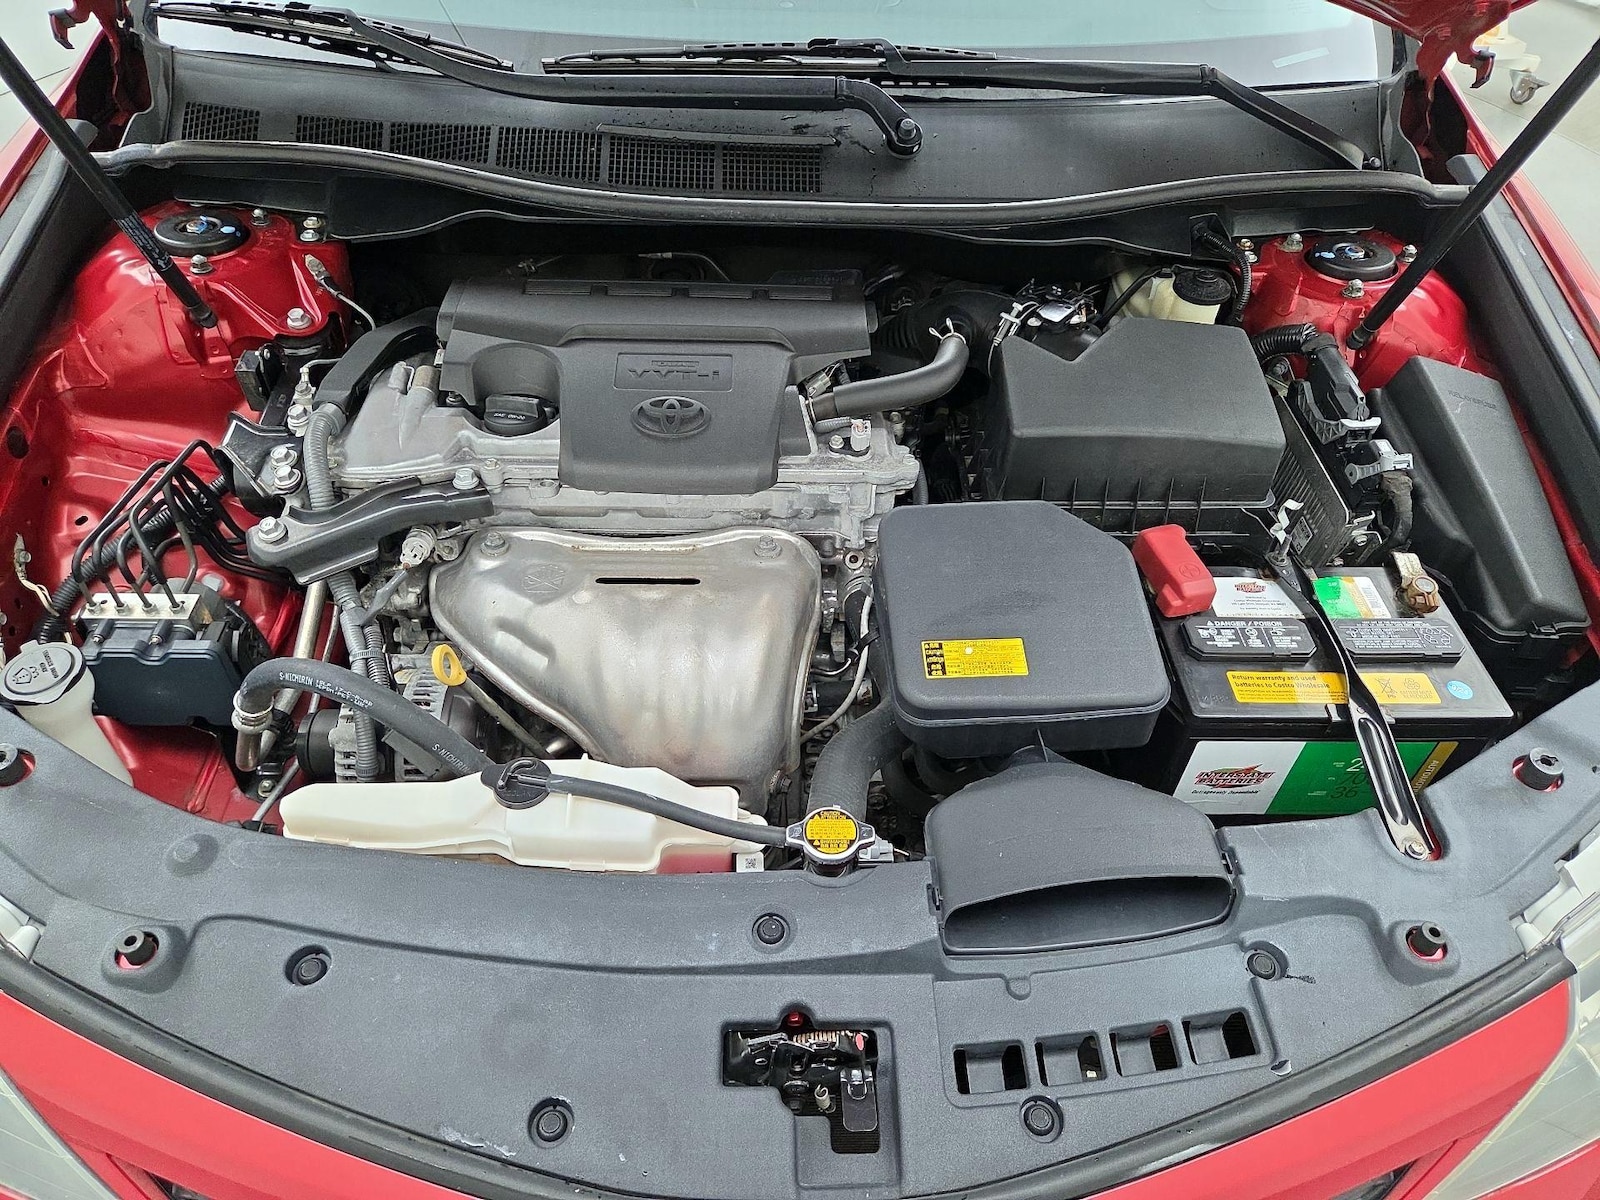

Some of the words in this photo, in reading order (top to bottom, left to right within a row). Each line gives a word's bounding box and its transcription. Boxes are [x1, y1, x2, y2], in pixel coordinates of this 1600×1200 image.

[1346, 757, 1364, 772] 2
[1195, 771, 1276, 779] INTERSTATE
[1413, 760, 1440, 793] AUTOMOTI
